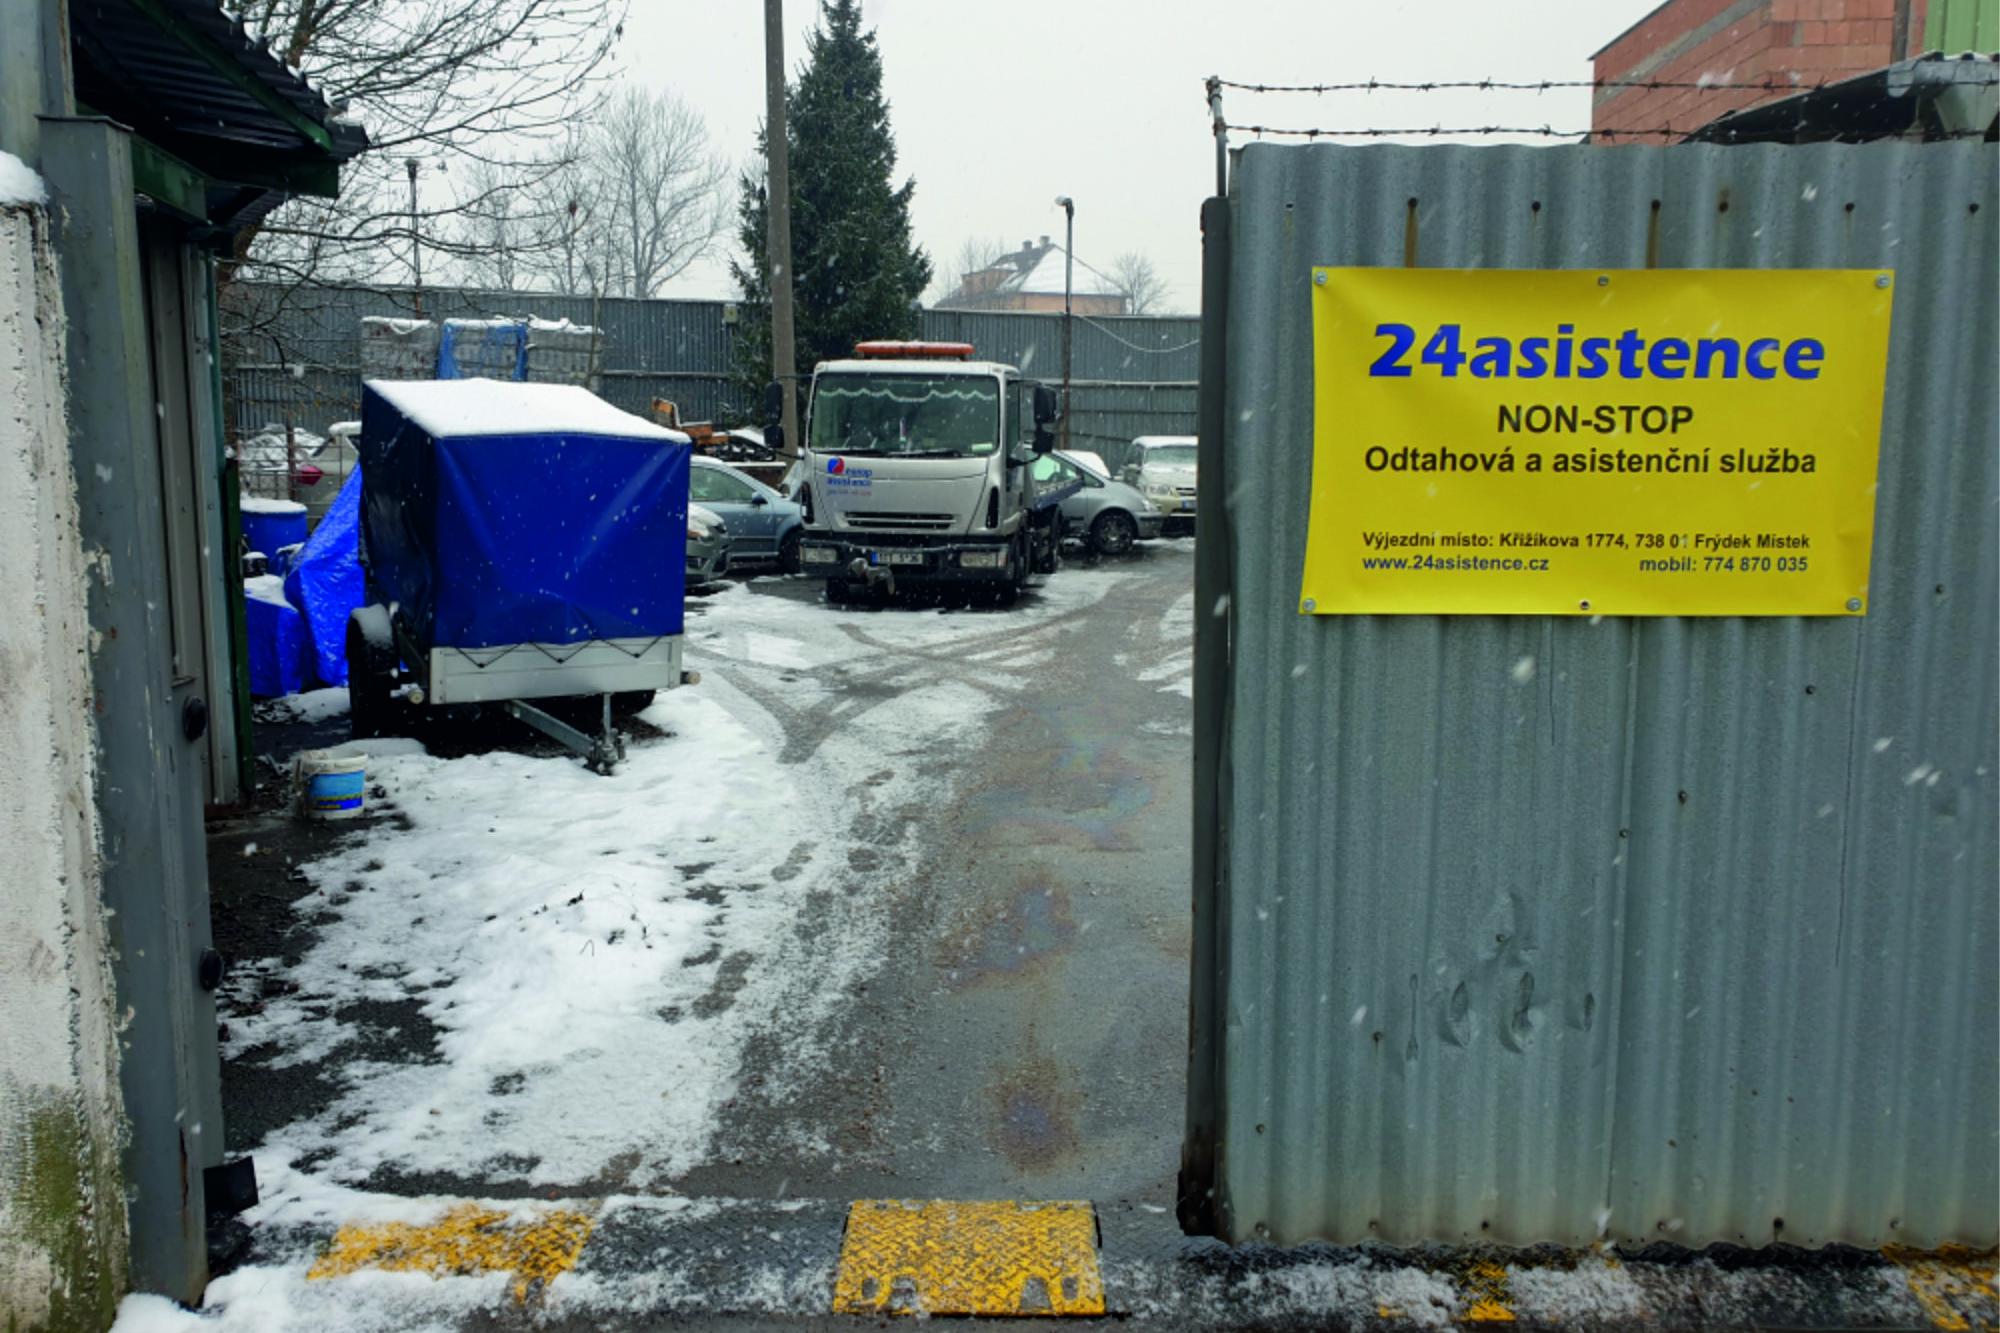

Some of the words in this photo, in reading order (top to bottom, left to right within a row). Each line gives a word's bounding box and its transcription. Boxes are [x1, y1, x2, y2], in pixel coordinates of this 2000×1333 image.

[1368, 322, 1826, 381] 24asistence
[1497, 404, 1694, 435] NON-STOP
[1365, 445, 1515, 473] Odtahová
[1524, 453, 1542, 473] a
[1552, 447, 1711, 474] asistenční
[1719, 447, 1817, 474] služba
[1362, 531, 1435, 551] Výjezdní
[1440, 532, 1494, 547] místo:
[1585, 533, 1629, 550] 1774,
[1635, 533, 1665, 549] 738
[1694, 533, 1752, 553] Frýdek
[1362, 554, 1550, 571] www.24asistence.cz
[1639, 556, 1697, 572] mobil:
[1703, 556, 1735, 572] 774
[1739, 556, 1772, 573] 870
[1776, 556, 1809, 573] 035
